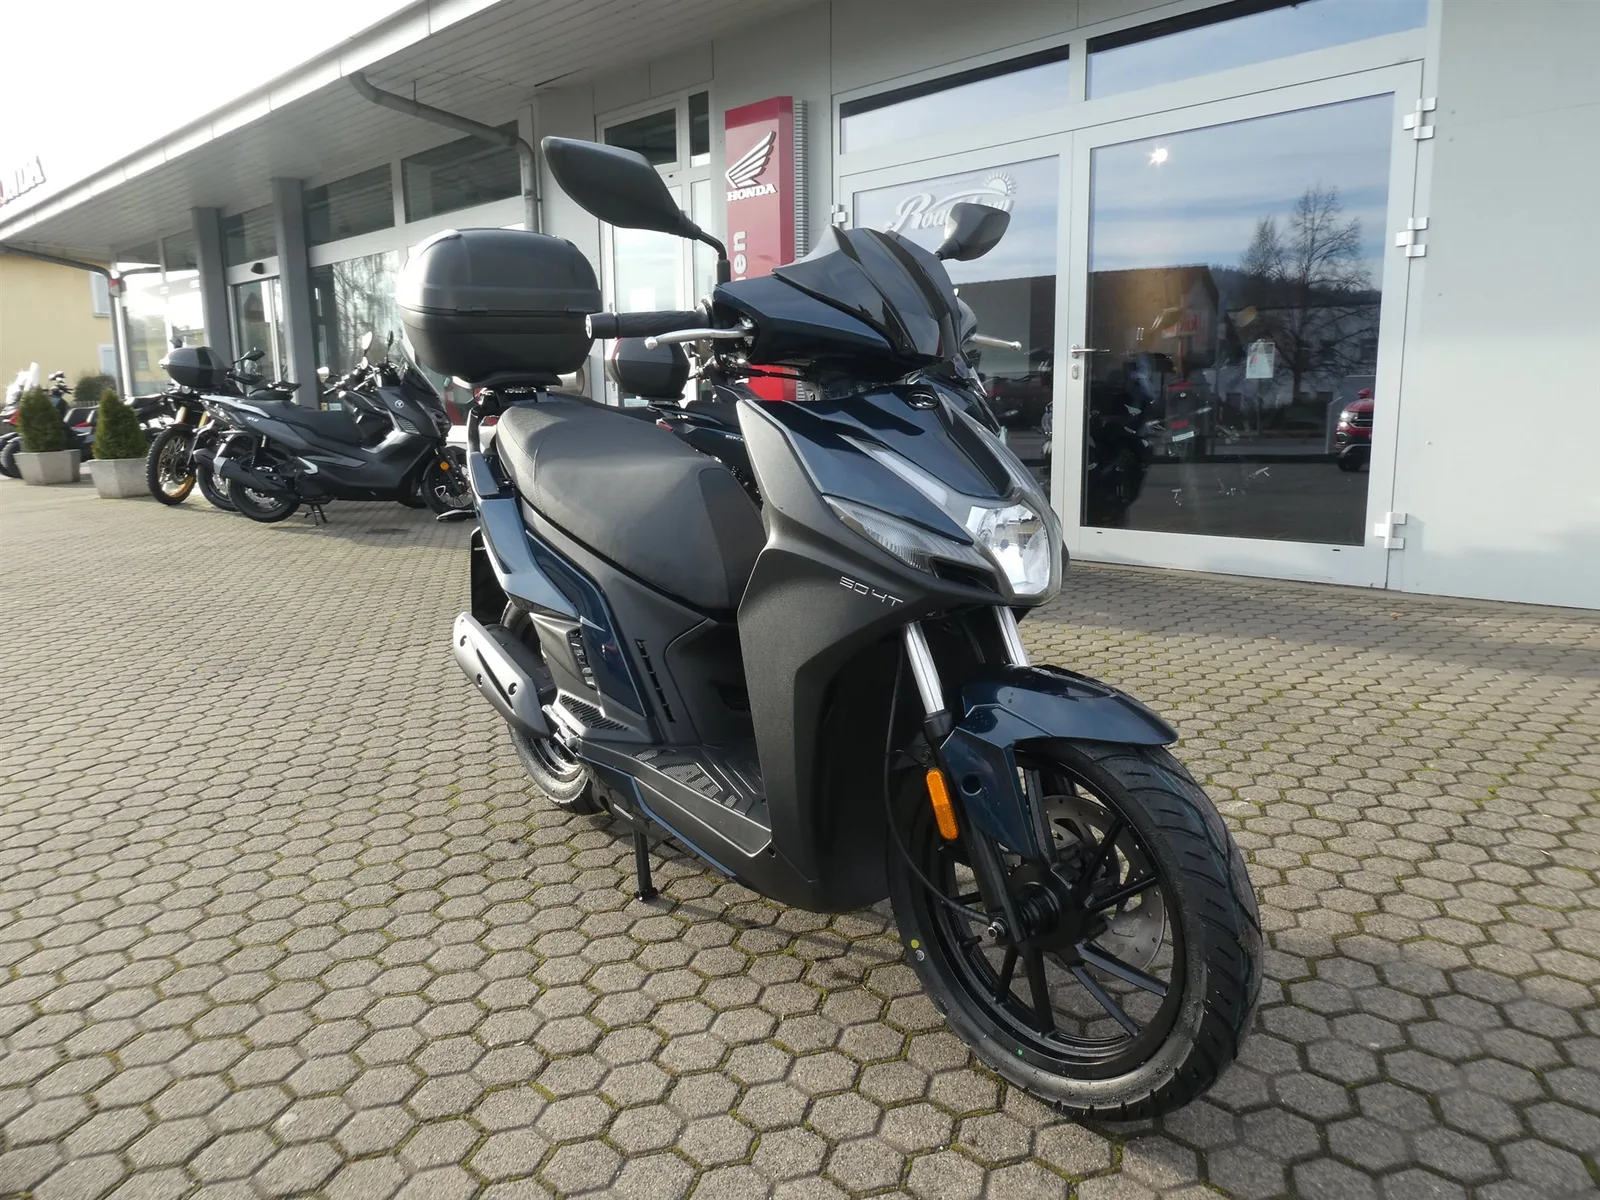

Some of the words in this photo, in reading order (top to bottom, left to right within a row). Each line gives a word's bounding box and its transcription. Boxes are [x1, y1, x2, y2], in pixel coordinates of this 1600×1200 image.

[727, 183, 776, 202] HONDA
[733, 230, 747, 282] en
[839, 576, 869, 595] 50
[871, 589, 904, 607] 4T
